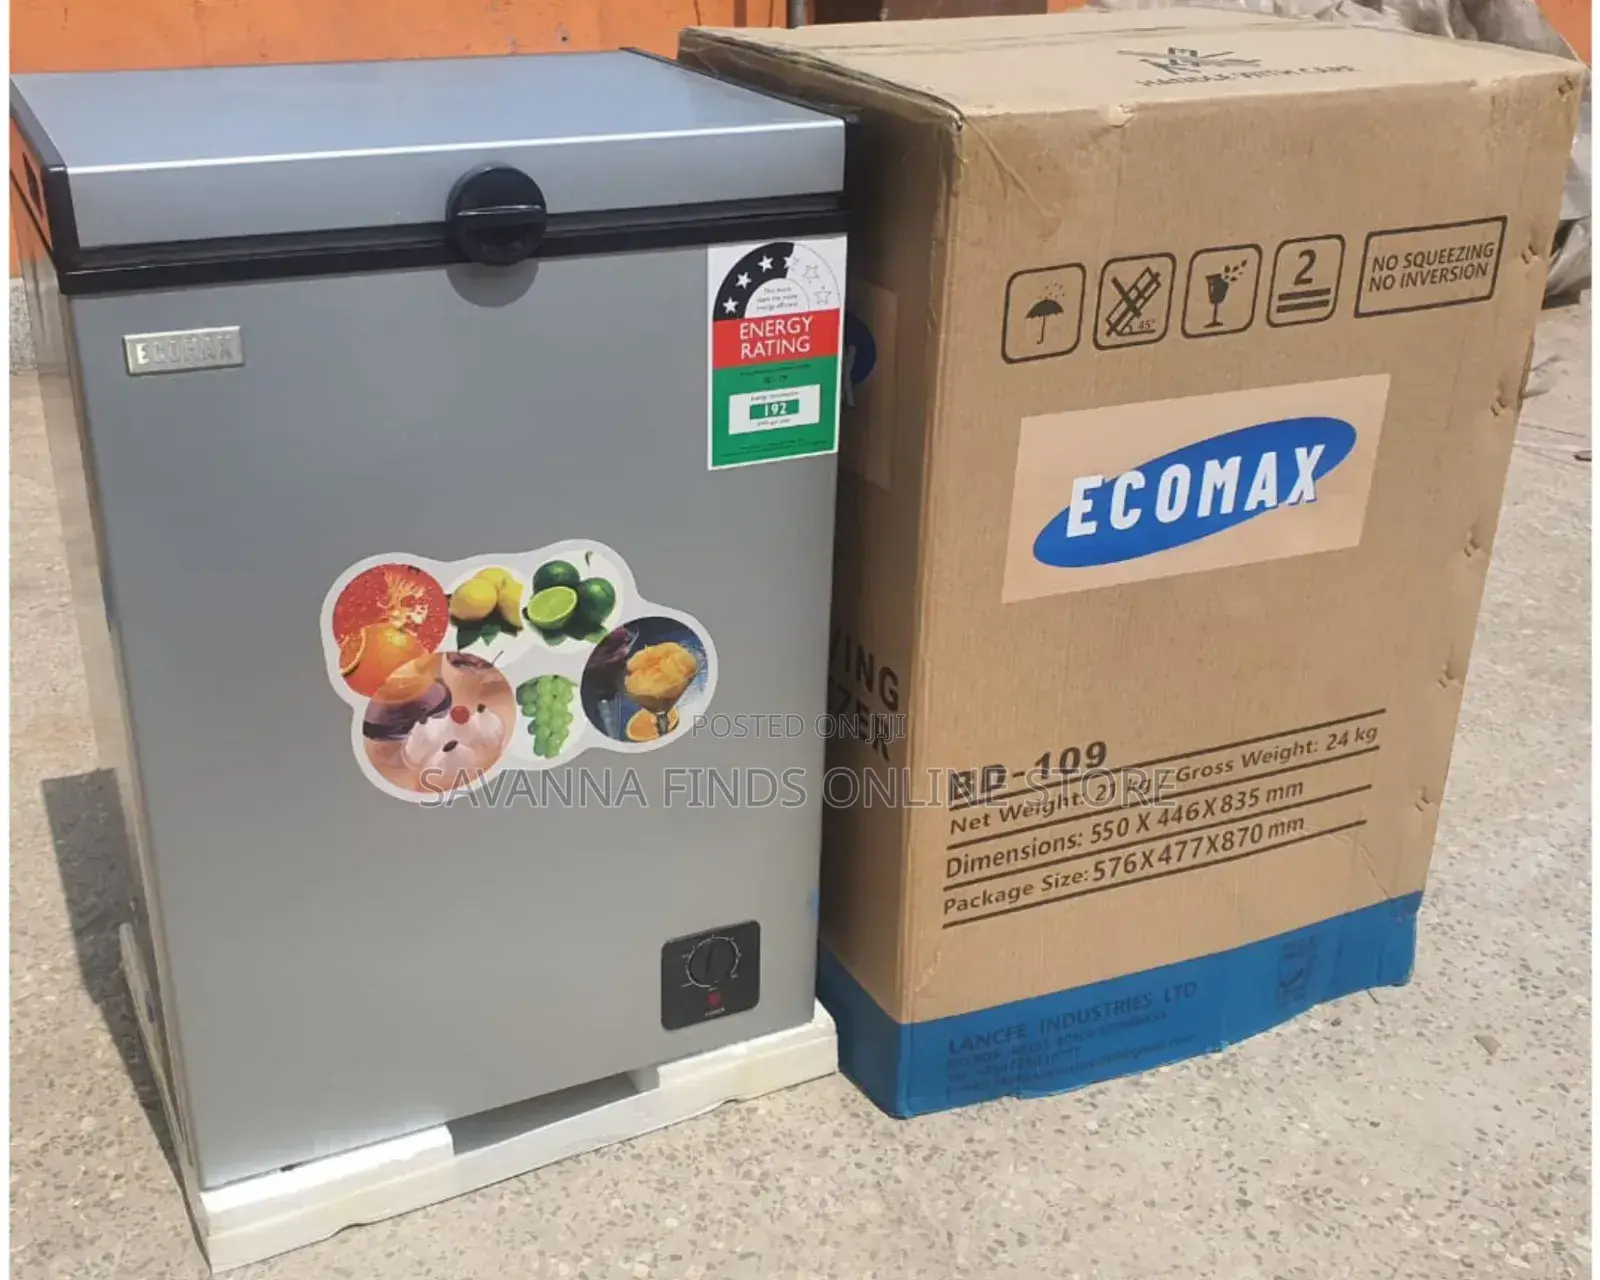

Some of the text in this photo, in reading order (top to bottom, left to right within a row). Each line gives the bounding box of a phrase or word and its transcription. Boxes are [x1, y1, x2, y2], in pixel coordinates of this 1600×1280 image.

[1294, 248, 1316, 286] 2
[1368, 261, 1489, 293] NO INVERSION
[1371, 241, 1496, 274] NO SQUEEZING
[739, 315, 814, 341] ENERGY
[740, 335, 811, 361] RATING
[764, 402, 787, 417] 192
[1065, 443, 1327, 539] ECOMAX
[949, 741, 1108, 801] BD-109
[950, 813, 991, 837] Net
[999, 792, 1085, 824] Weight:
[1176, 759, 1235, 783] Gross
[1242, 739, 1319, 769] Weight:
[1326, 730, 1349, 751] 24
[1354, 726, 1378, 744] kg
[946, 833, 1083, 879] Dimensions:
[1090, 817, 1130, 844] 550
[1135, 811, 1152, 834] X
[1266, 781, 1304, 803] mm
[943, 883, 1035, 915] Package
[1040, 872, 1089, 893] Size:
[1267, 817, 1305, 840] mm
[1040, 991, 1153, 1035] INDUSTRIES
[1163, 980, 1198, 1004] LTD
